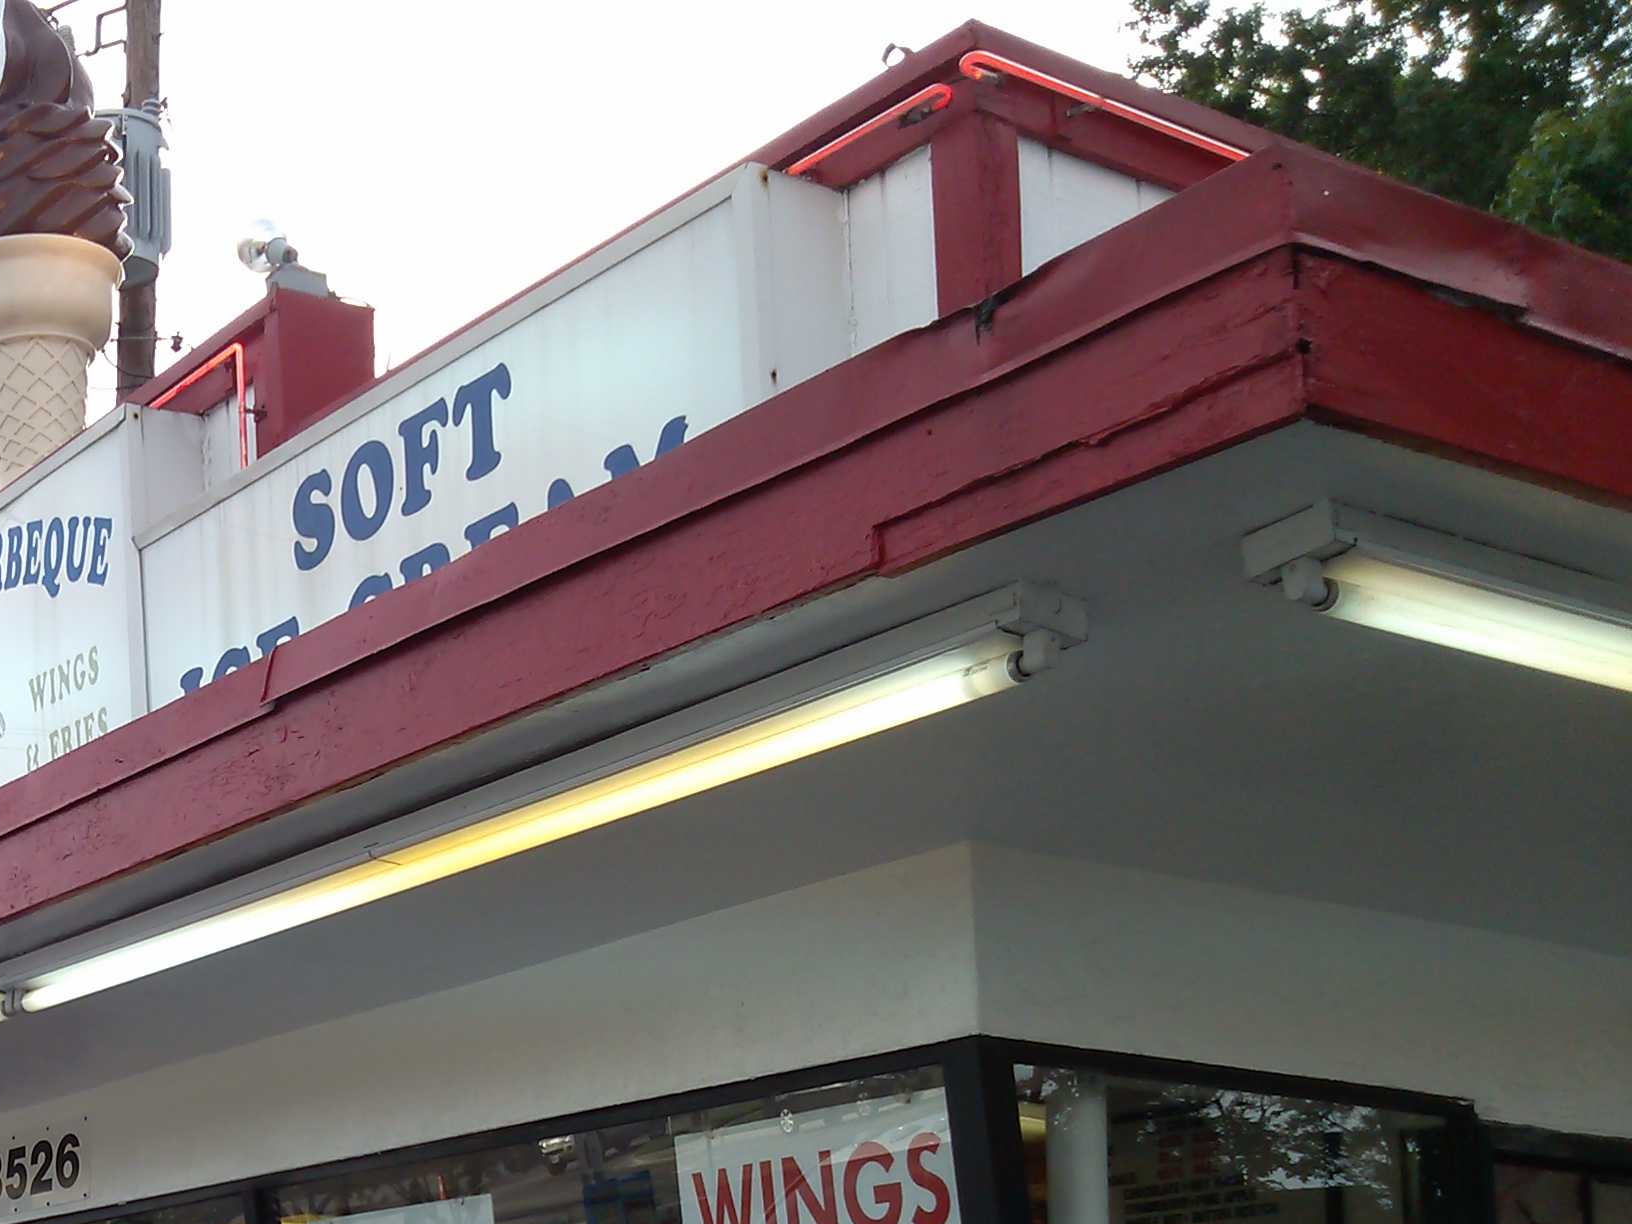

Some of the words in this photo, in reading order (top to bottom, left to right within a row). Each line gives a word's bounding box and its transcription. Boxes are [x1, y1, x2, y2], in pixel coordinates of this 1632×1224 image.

[292, 361, 511, 571] SOFT
[28, 645, 99, 713] WINGS
[48, 706, 108, 761] FRIES
